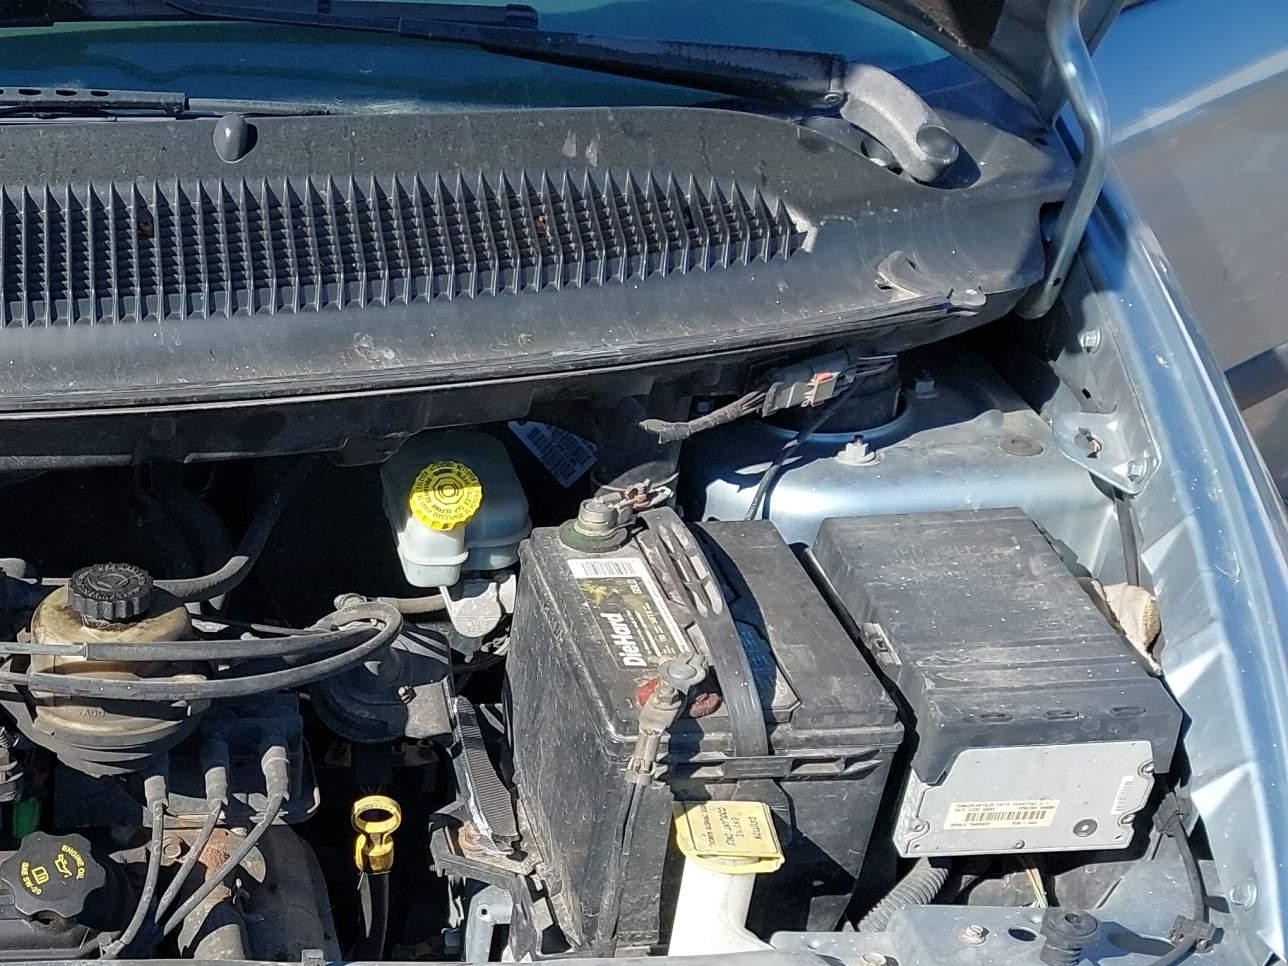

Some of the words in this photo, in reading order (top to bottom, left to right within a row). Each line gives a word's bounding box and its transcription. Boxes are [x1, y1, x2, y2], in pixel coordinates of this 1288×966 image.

[600, 613, 647, 666] DieHard
[717, 807, 732, 832] COOLANT
[21, 861, 29, 876] SAE
[62, 845, 85, 867] ENGINE
[76, 867, 85, 880] OIL
